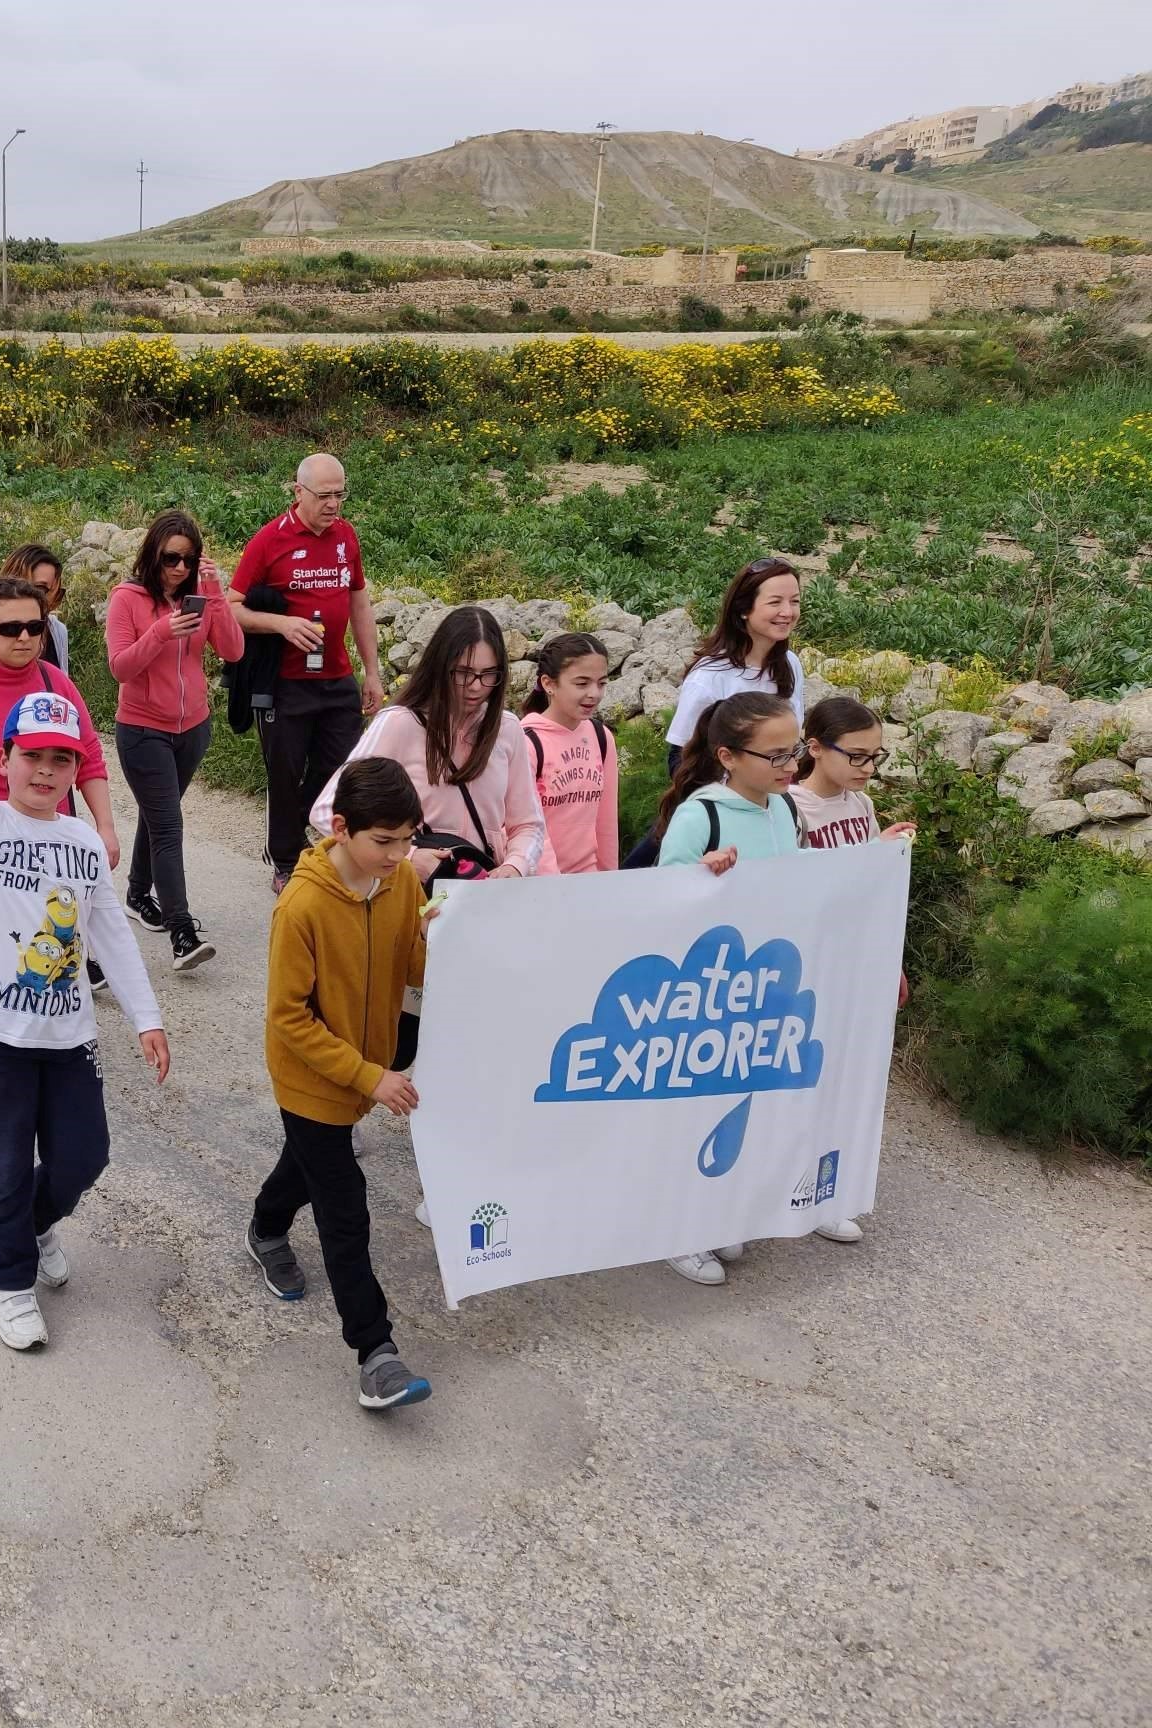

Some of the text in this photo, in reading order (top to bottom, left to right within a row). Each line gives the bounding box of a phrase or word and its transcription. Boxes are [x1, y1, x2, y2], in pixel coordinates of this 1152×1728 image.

[293, 567, 339, 579] Standard
[289, 578, 339, 590] Chartered
[561, 747, 591, 764] MAGIC
[552, 767, 603, 791] THINGS ARE
[564, 1015, 807, 1093] EXPLORER
[817, 1182, 834, 1201] FEE
[466, 1248, 512, 1266] Eco-Schools
